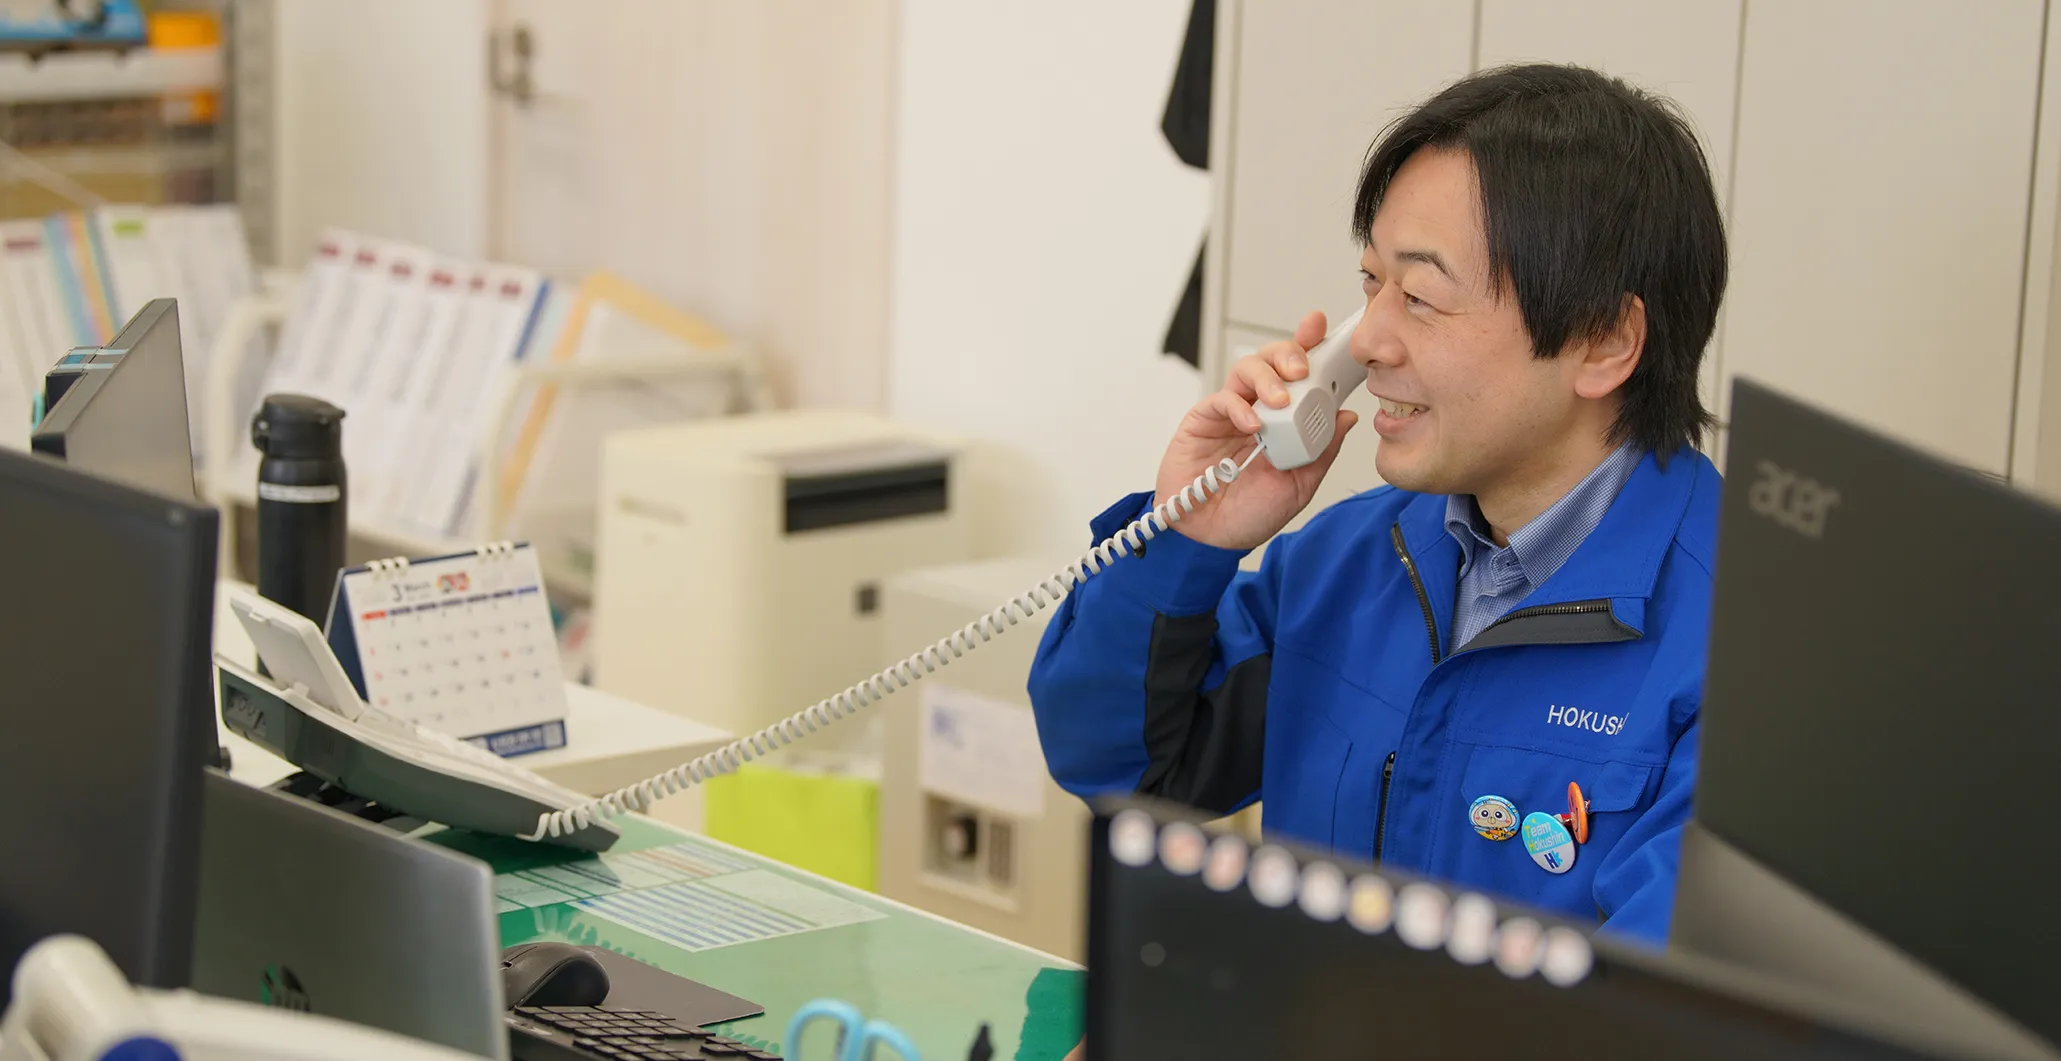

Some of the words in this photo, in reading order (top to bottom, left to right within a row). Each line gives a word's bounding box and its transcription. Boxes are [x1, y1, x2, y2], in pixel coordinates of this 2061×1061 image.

[1748, 459, 1840, 538] acer
[1524, 821, 1552, 838] Team
[1528, 831, 1565, 852] Hokushin
